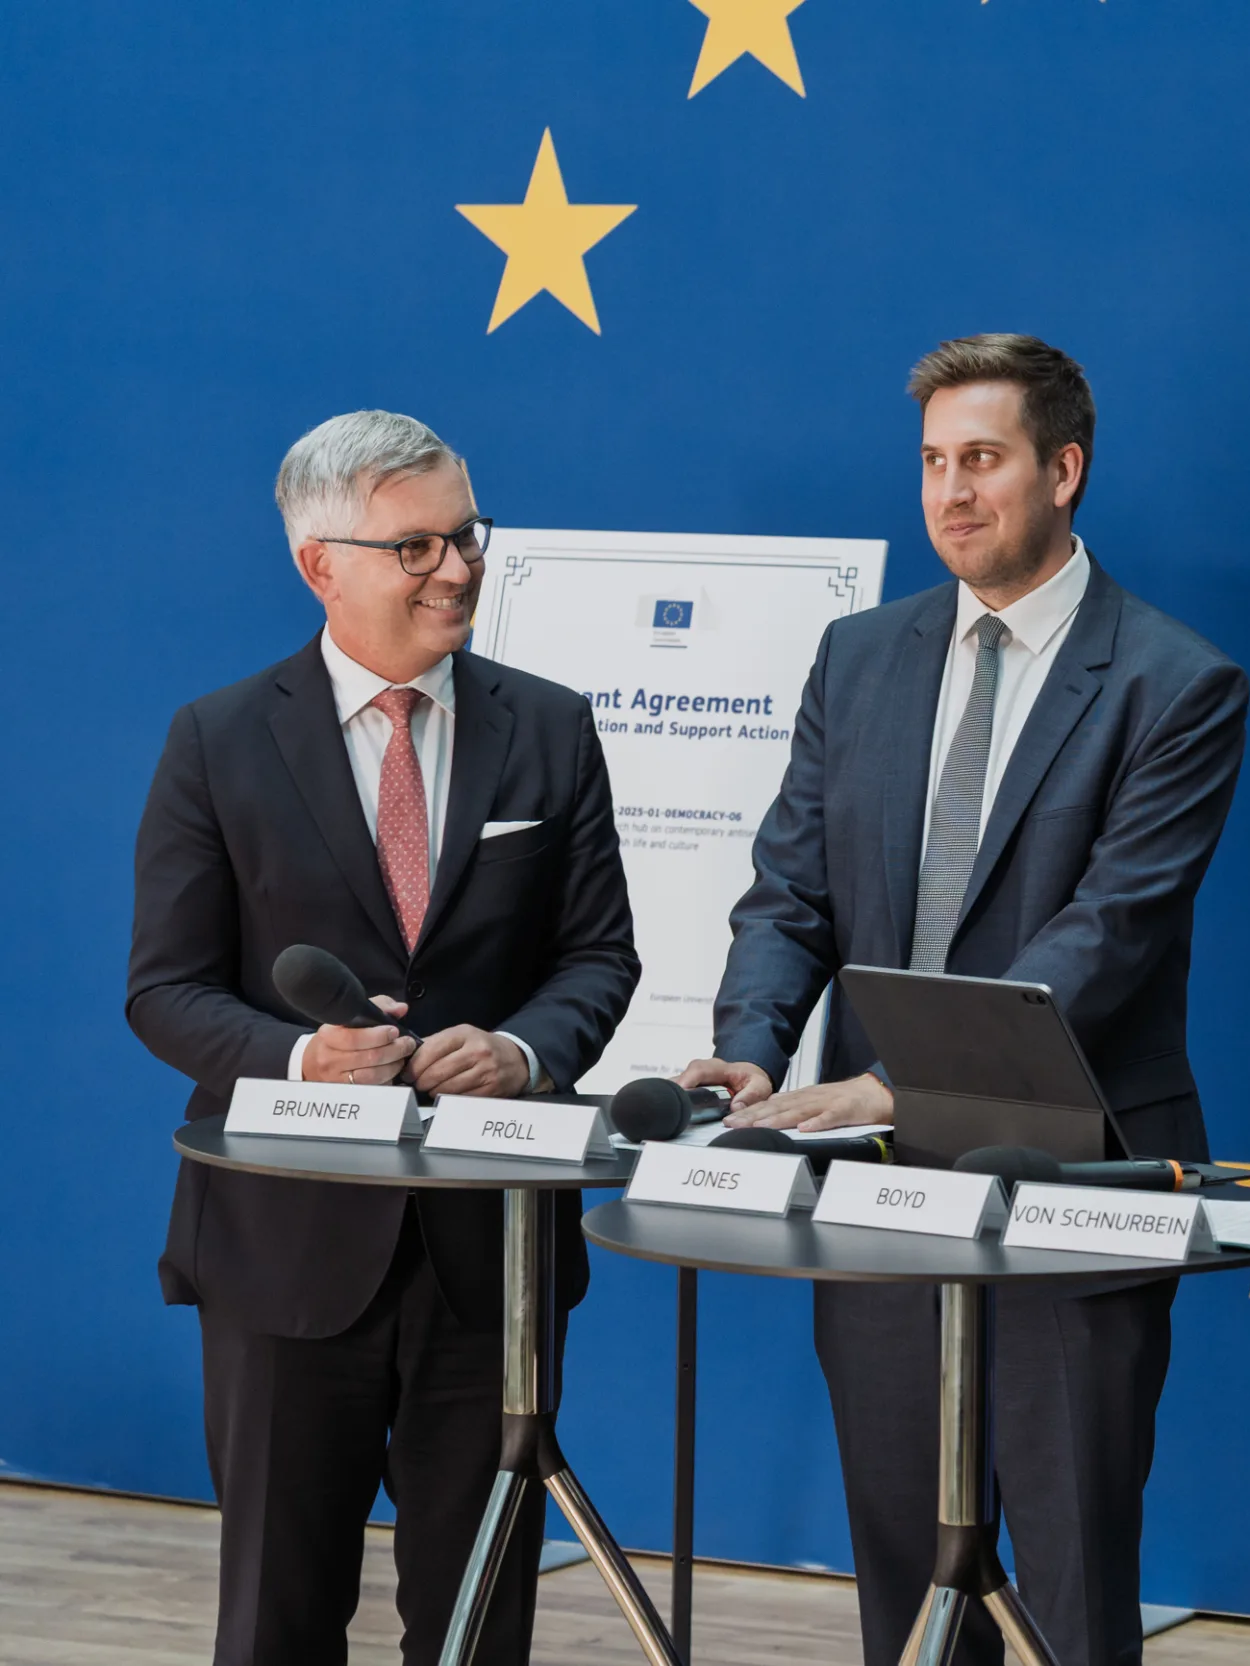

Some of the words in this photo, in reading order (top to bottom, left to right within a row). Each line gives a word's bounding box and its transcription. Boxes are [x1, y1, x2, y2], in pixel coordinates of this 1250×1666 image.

[583, 688, 622, 709] ant
[630, 688, 773, 717] Agreement
[597, 719, 628, 733] tion
[634, 720, 664, 735] and
[669, 721, 732, 740] Support
[737, 724, 791, 742] Action
[272, 1100, 360, 1120] BRUNNER
[481, 1119, 536, 1140] PRÖLL
[681, 1169, 742, 1190] JONES
[876, 1187, 926, 1208] BOYD
[1013, 1205, 1056, 1225] VON
[1060, 1208, 1190, 1236] SCHNURBEIN
